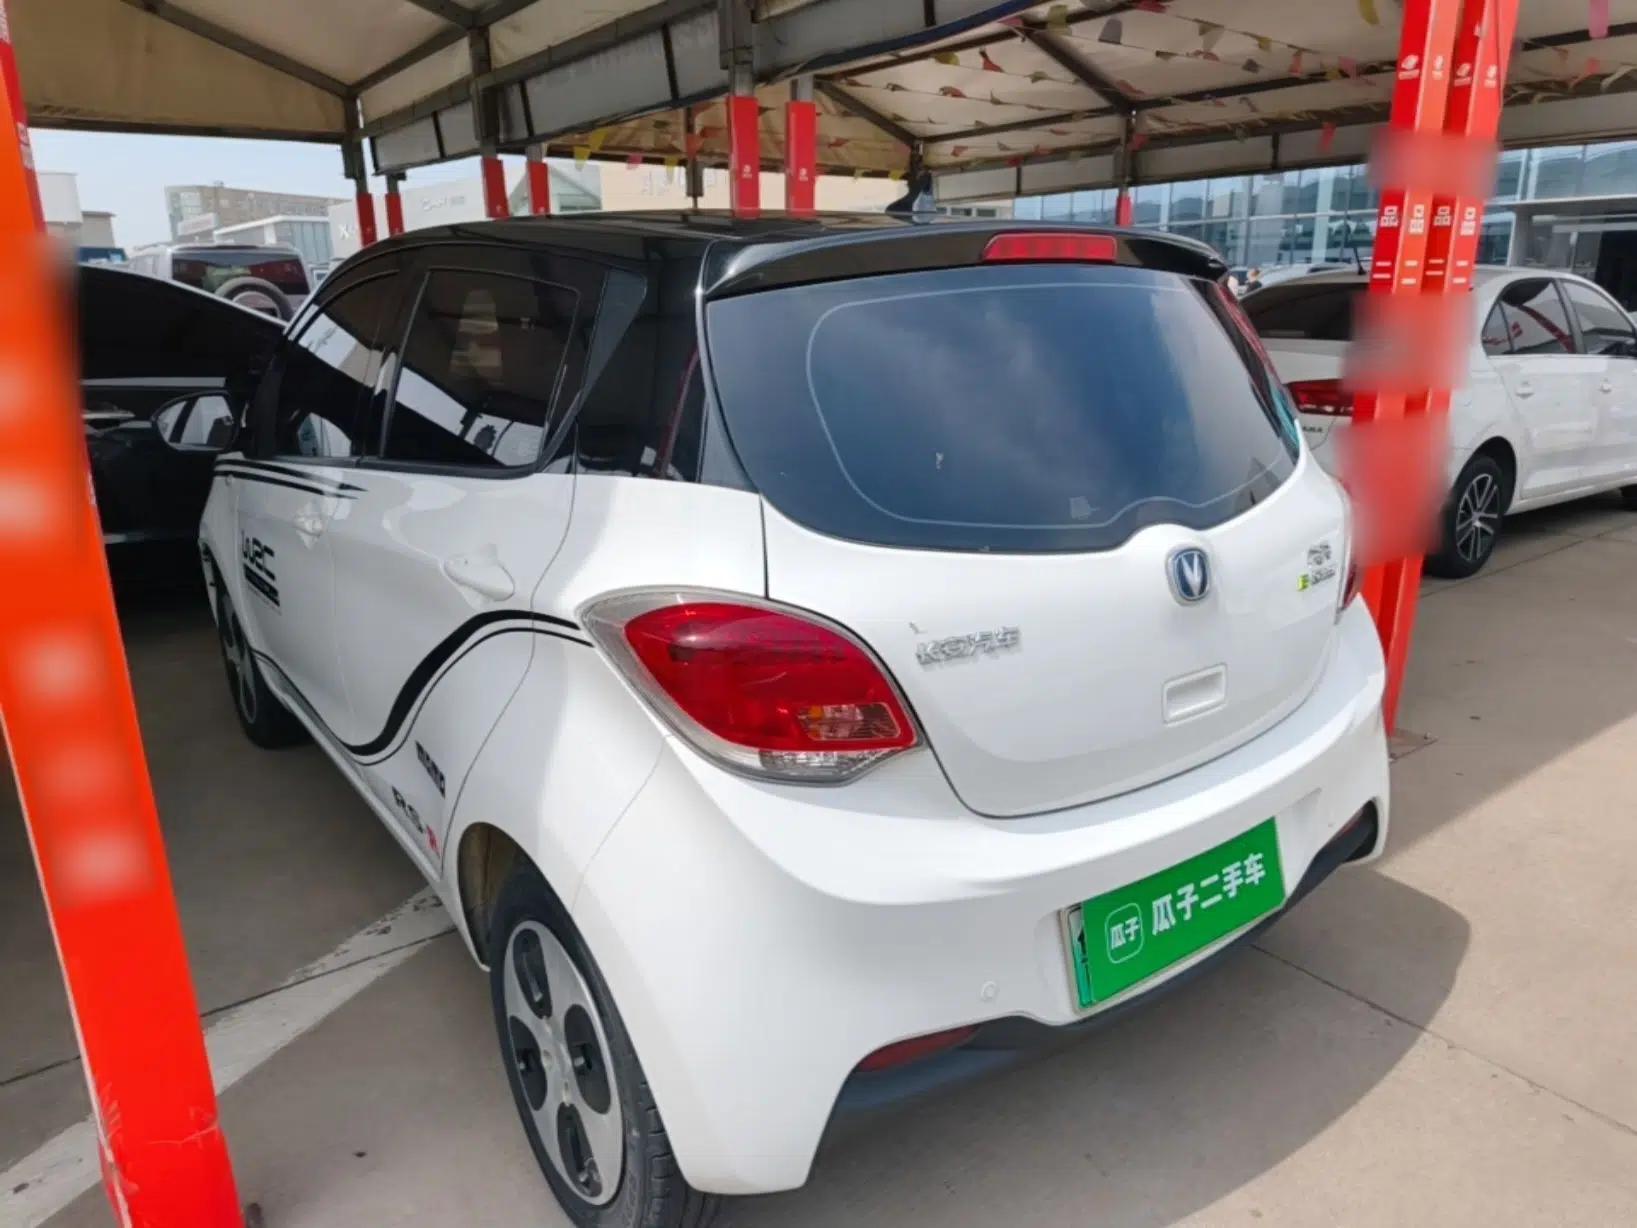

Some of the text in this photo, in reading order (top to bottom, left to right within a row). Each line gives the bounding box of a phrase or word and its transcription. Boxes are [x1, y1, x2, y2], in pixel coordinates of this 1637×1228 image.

[1151, 853, 1266, 936] 瓜子二手车
[1110, 916, 1139, 950] 瓜子
